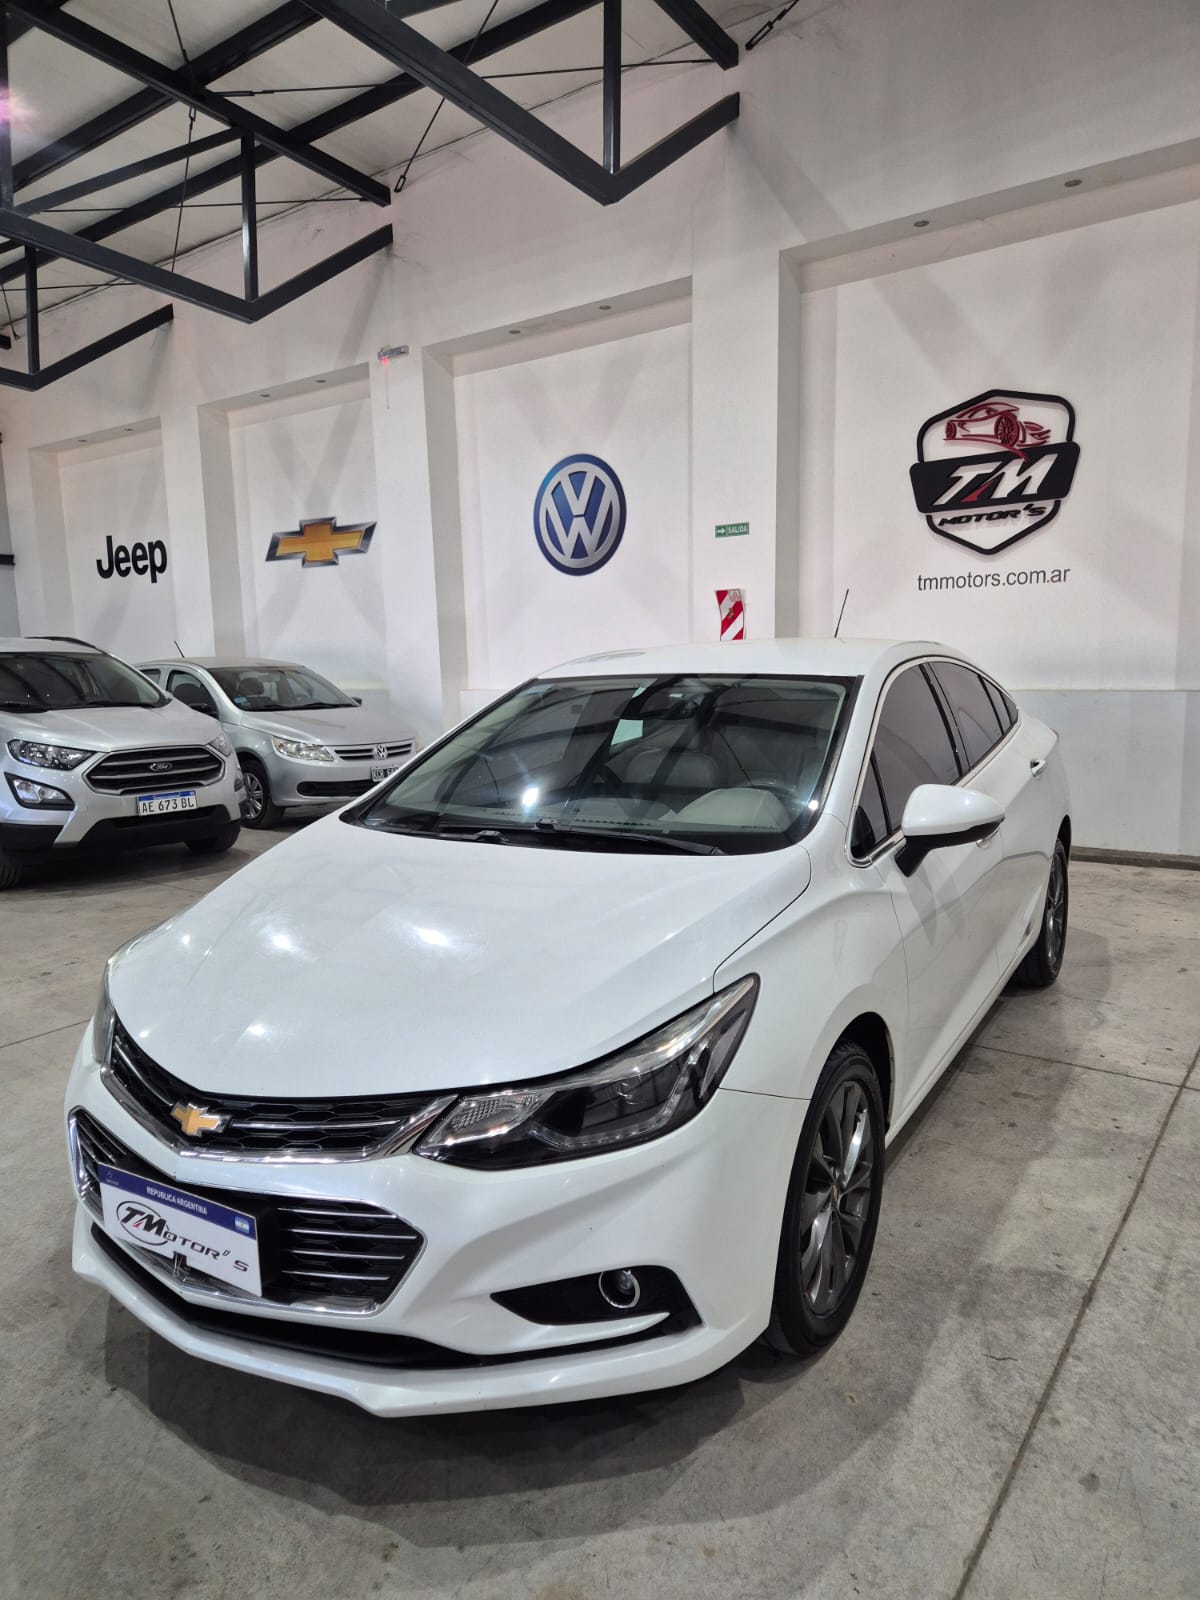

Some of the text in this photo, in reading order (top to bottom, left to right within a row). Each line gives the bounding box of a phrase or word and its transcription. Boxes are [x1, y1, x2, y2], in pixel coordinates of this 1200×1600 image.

[932, 453, 1059, 506] TM
[727, 524, 748, 534] SALIDA
[96, 535, 168, 584] Jeep
[917, 568, 1071, 591] tmmotors.com.ar
[142, 797, 194, 814] AE 673 BL
[177, 1197, 208, 1216] ARGENTINA
